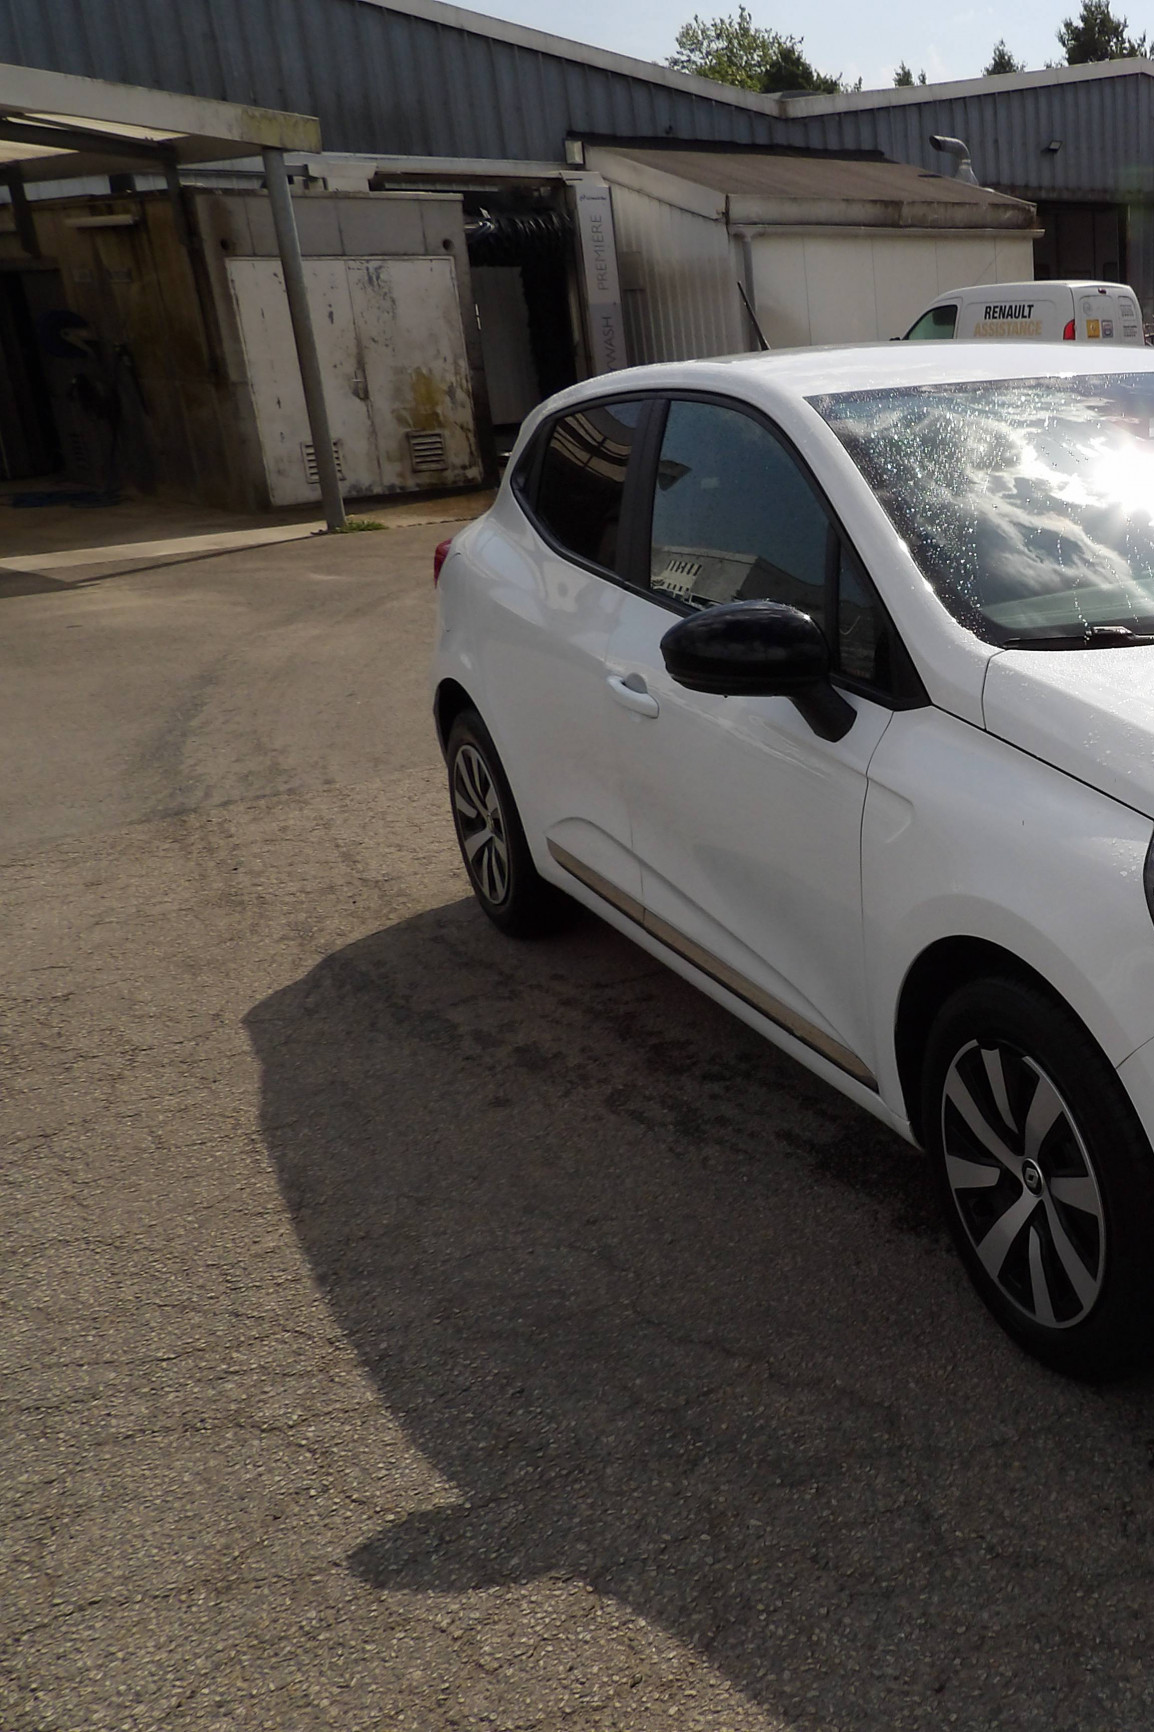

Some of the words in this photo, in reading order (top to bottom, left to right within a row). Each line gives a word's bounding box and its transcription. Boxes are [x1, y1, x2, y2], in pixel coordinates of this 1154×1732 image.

[590, 214, 609, 290] PREMIERE
[984, 304, 1034, 320] RENAULT
[974, 320, 1043, 337] ASSISTANCE
